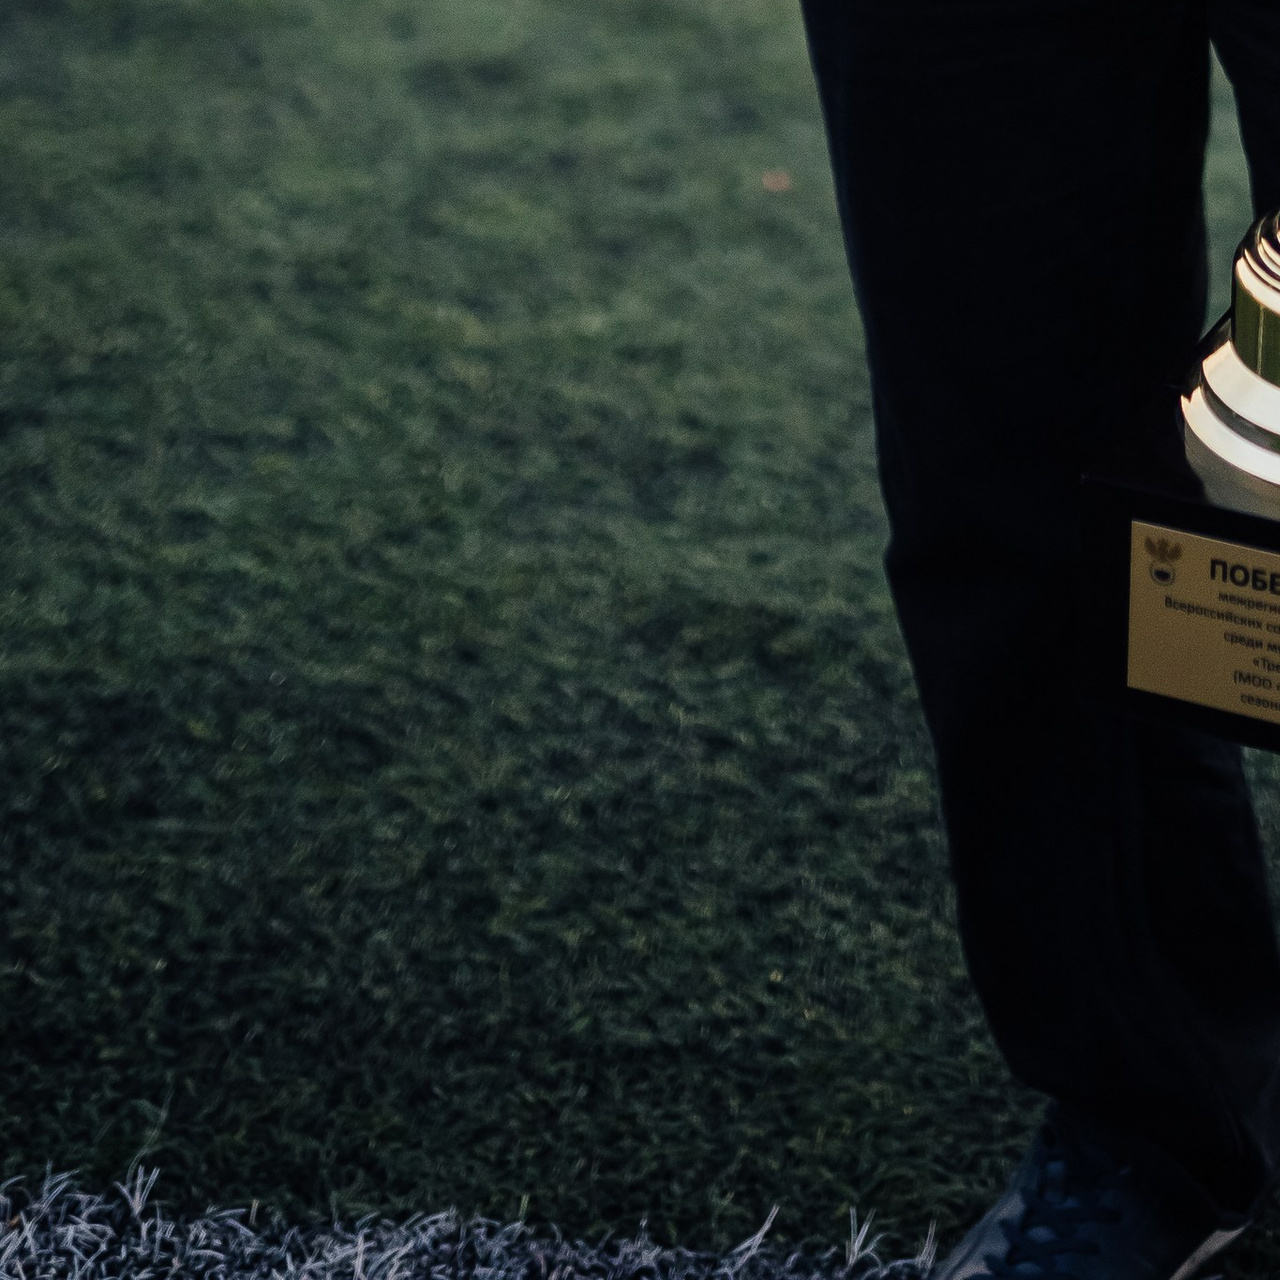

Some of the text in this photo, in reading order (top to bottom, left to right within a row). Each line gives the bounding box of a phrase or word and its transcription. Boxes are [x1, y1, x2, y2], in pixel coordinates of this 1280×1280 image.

[1165, 596, 1263, 630] Всероссийских
[1224, 631, 1263, 649] среди
[1233, 669, 1272, 690] (МОО
